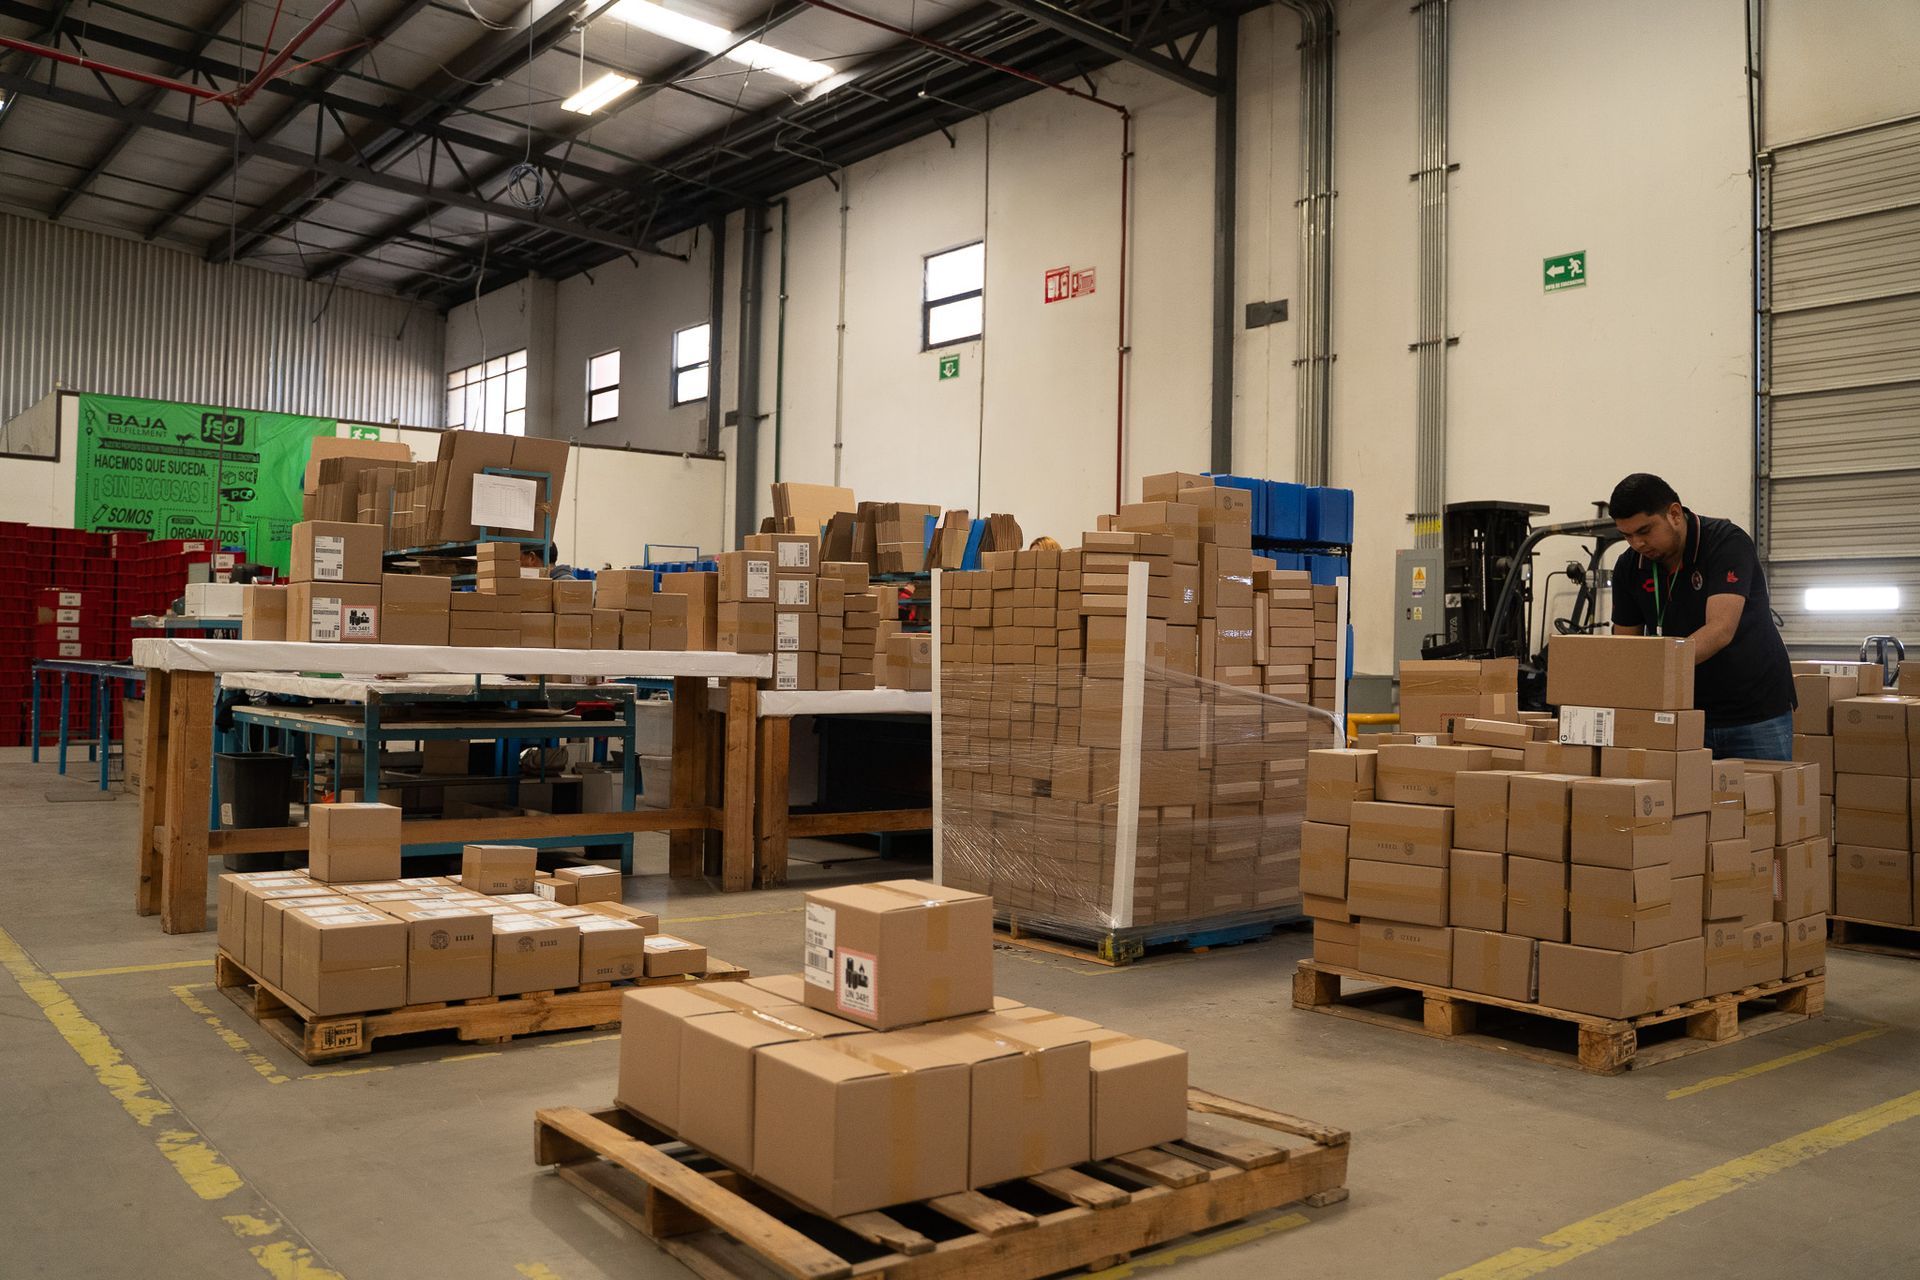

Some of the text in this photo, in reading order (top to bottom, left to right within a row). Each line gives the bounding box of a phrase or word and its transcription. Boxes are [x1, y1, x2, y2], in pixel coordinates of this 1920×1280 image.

[108, 413, 167, 430] BAJA
[203, 415, 239, 437] fsd
[107, 425, 167, 438] FULFILLMENT
[95, 454, 209, 478] HACEMOS QUE SUCEDA.
[108, 507, 153, 525] SOMOS
[170, 526, 240, 543] ORGANIZDOS
[845, 989, 870, 1004] UN 3481
